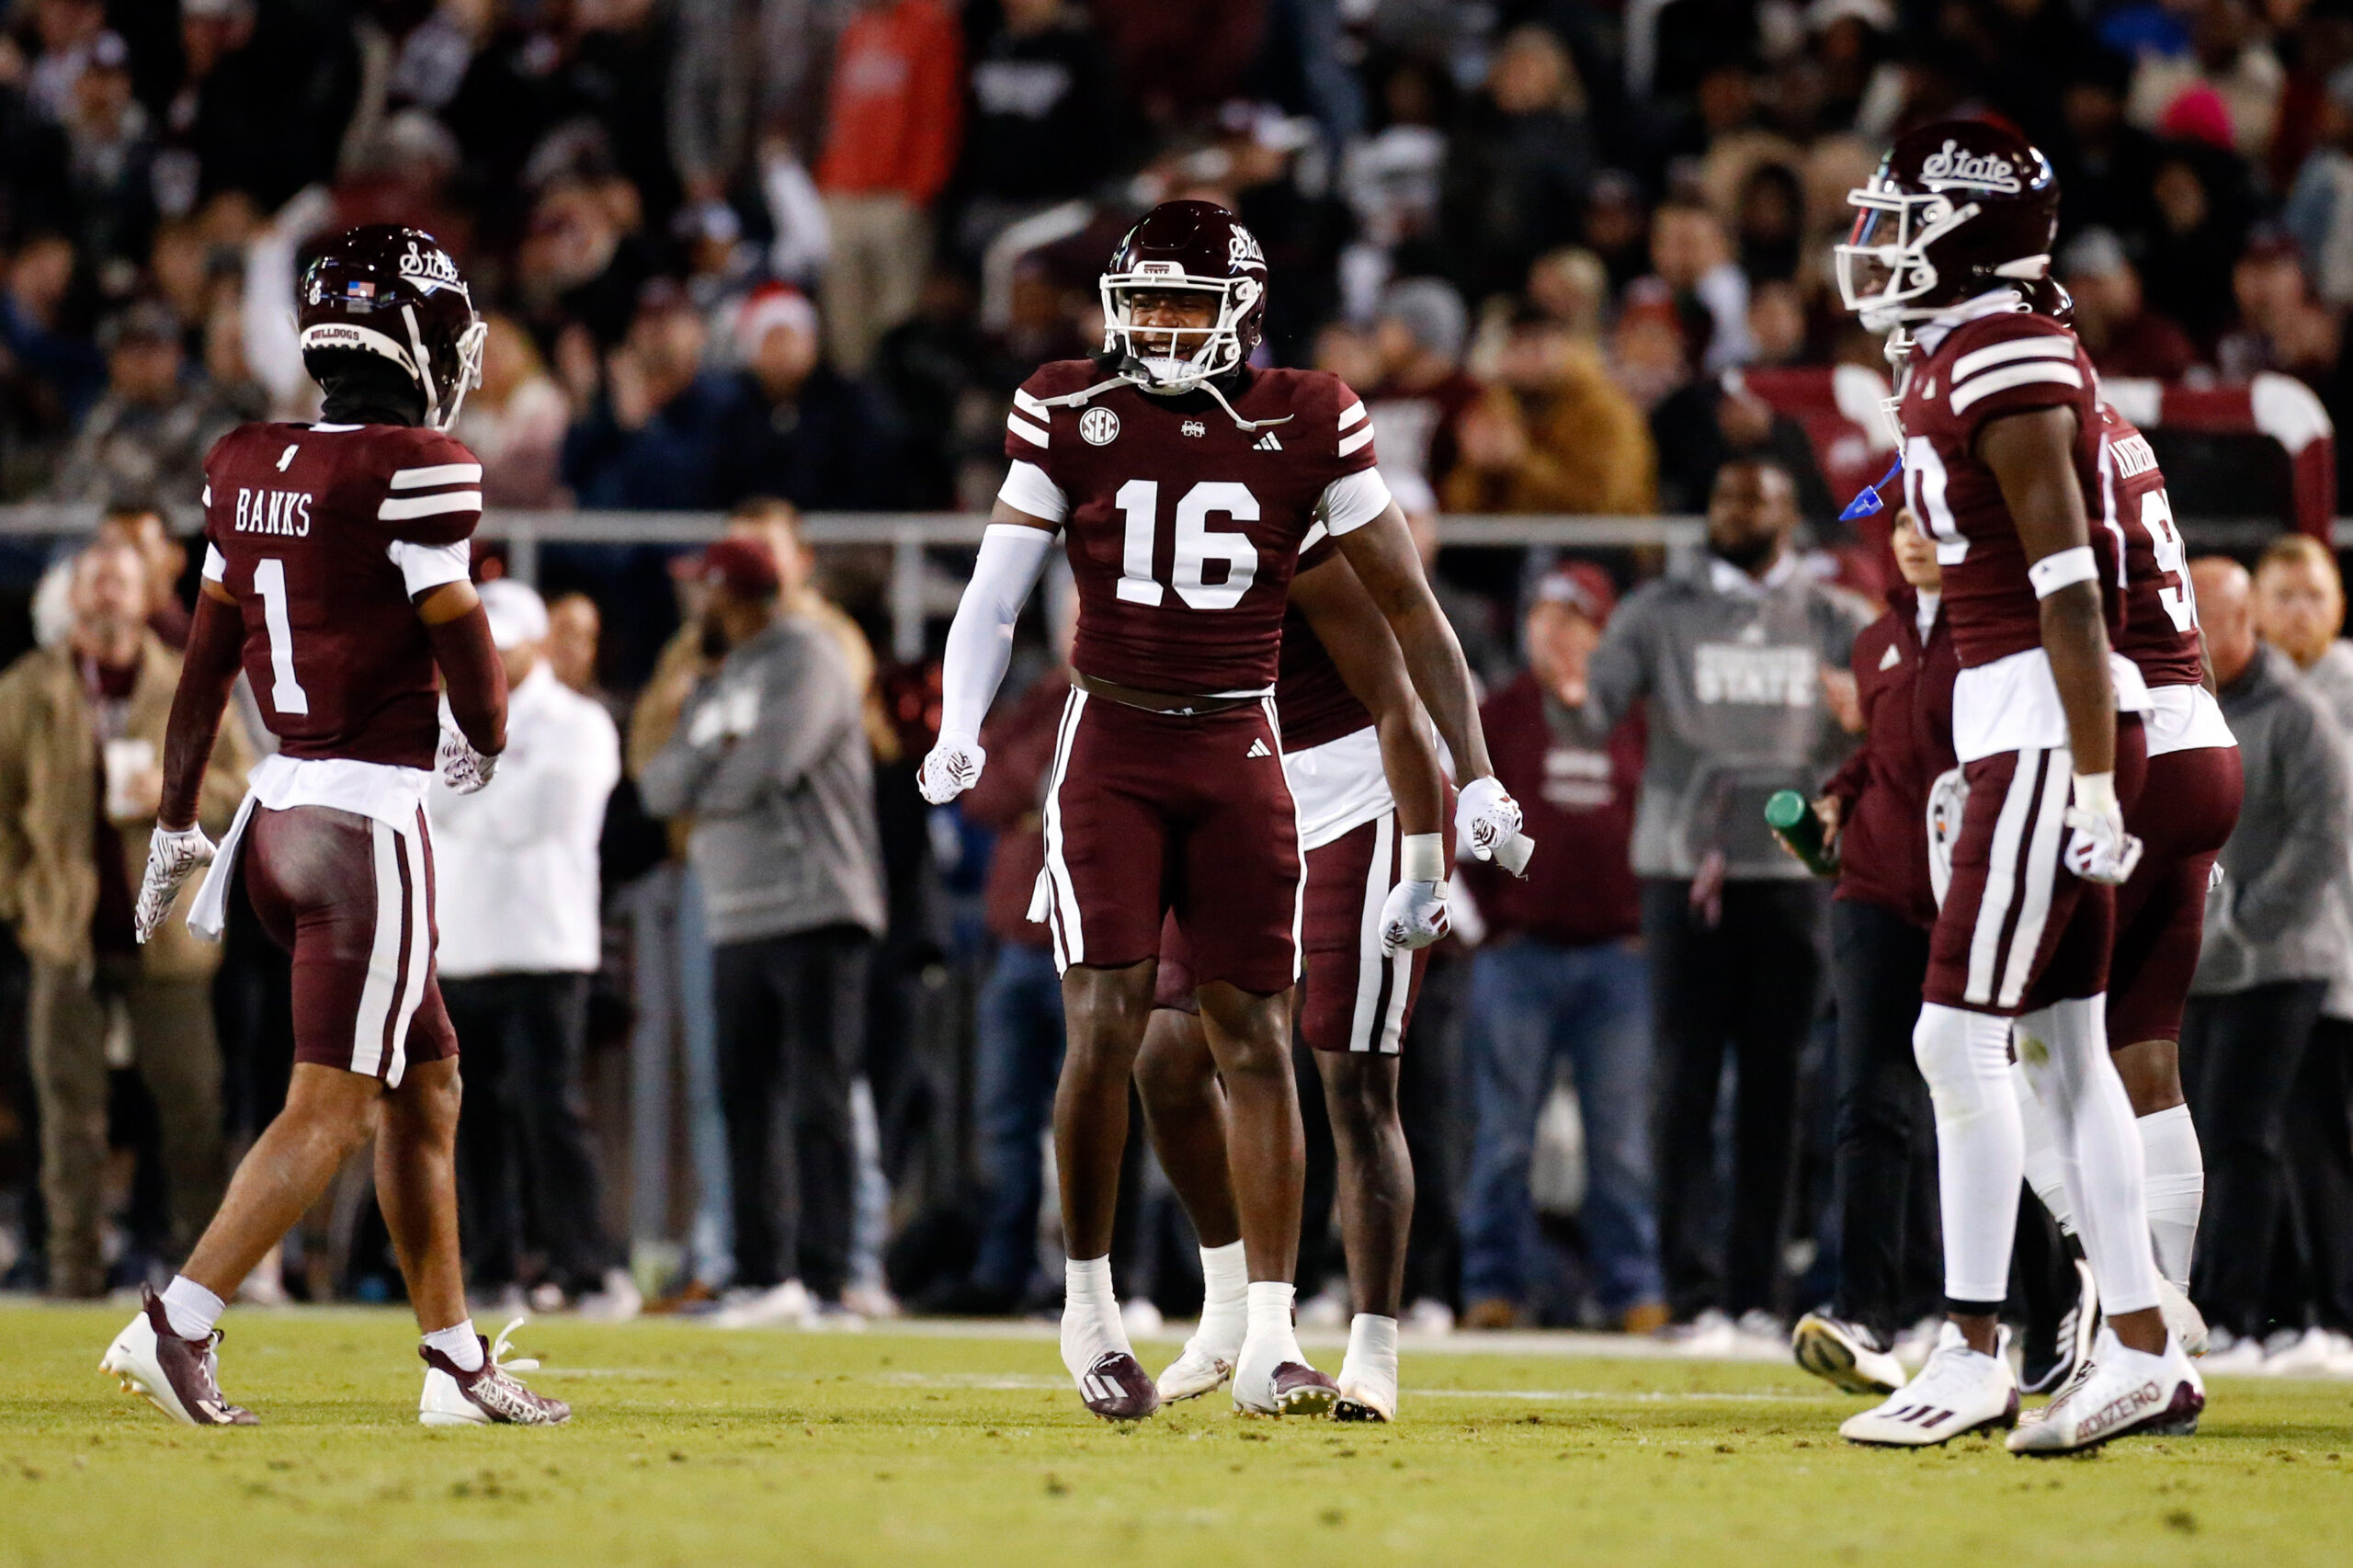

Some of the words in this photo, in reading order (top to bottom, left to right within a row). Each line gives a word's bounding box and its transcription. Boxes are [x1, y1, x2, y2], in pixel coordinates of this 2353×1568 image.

[1918, 139, 2021, 193] State
[1083, 409, 1117, 443] SEC
[235, 487, 313, 537] BANKS
[1115, 479, 1260, 609] 16
[2141, 488, 2200, 632] 9
[254, 558, 309, 715] 1
